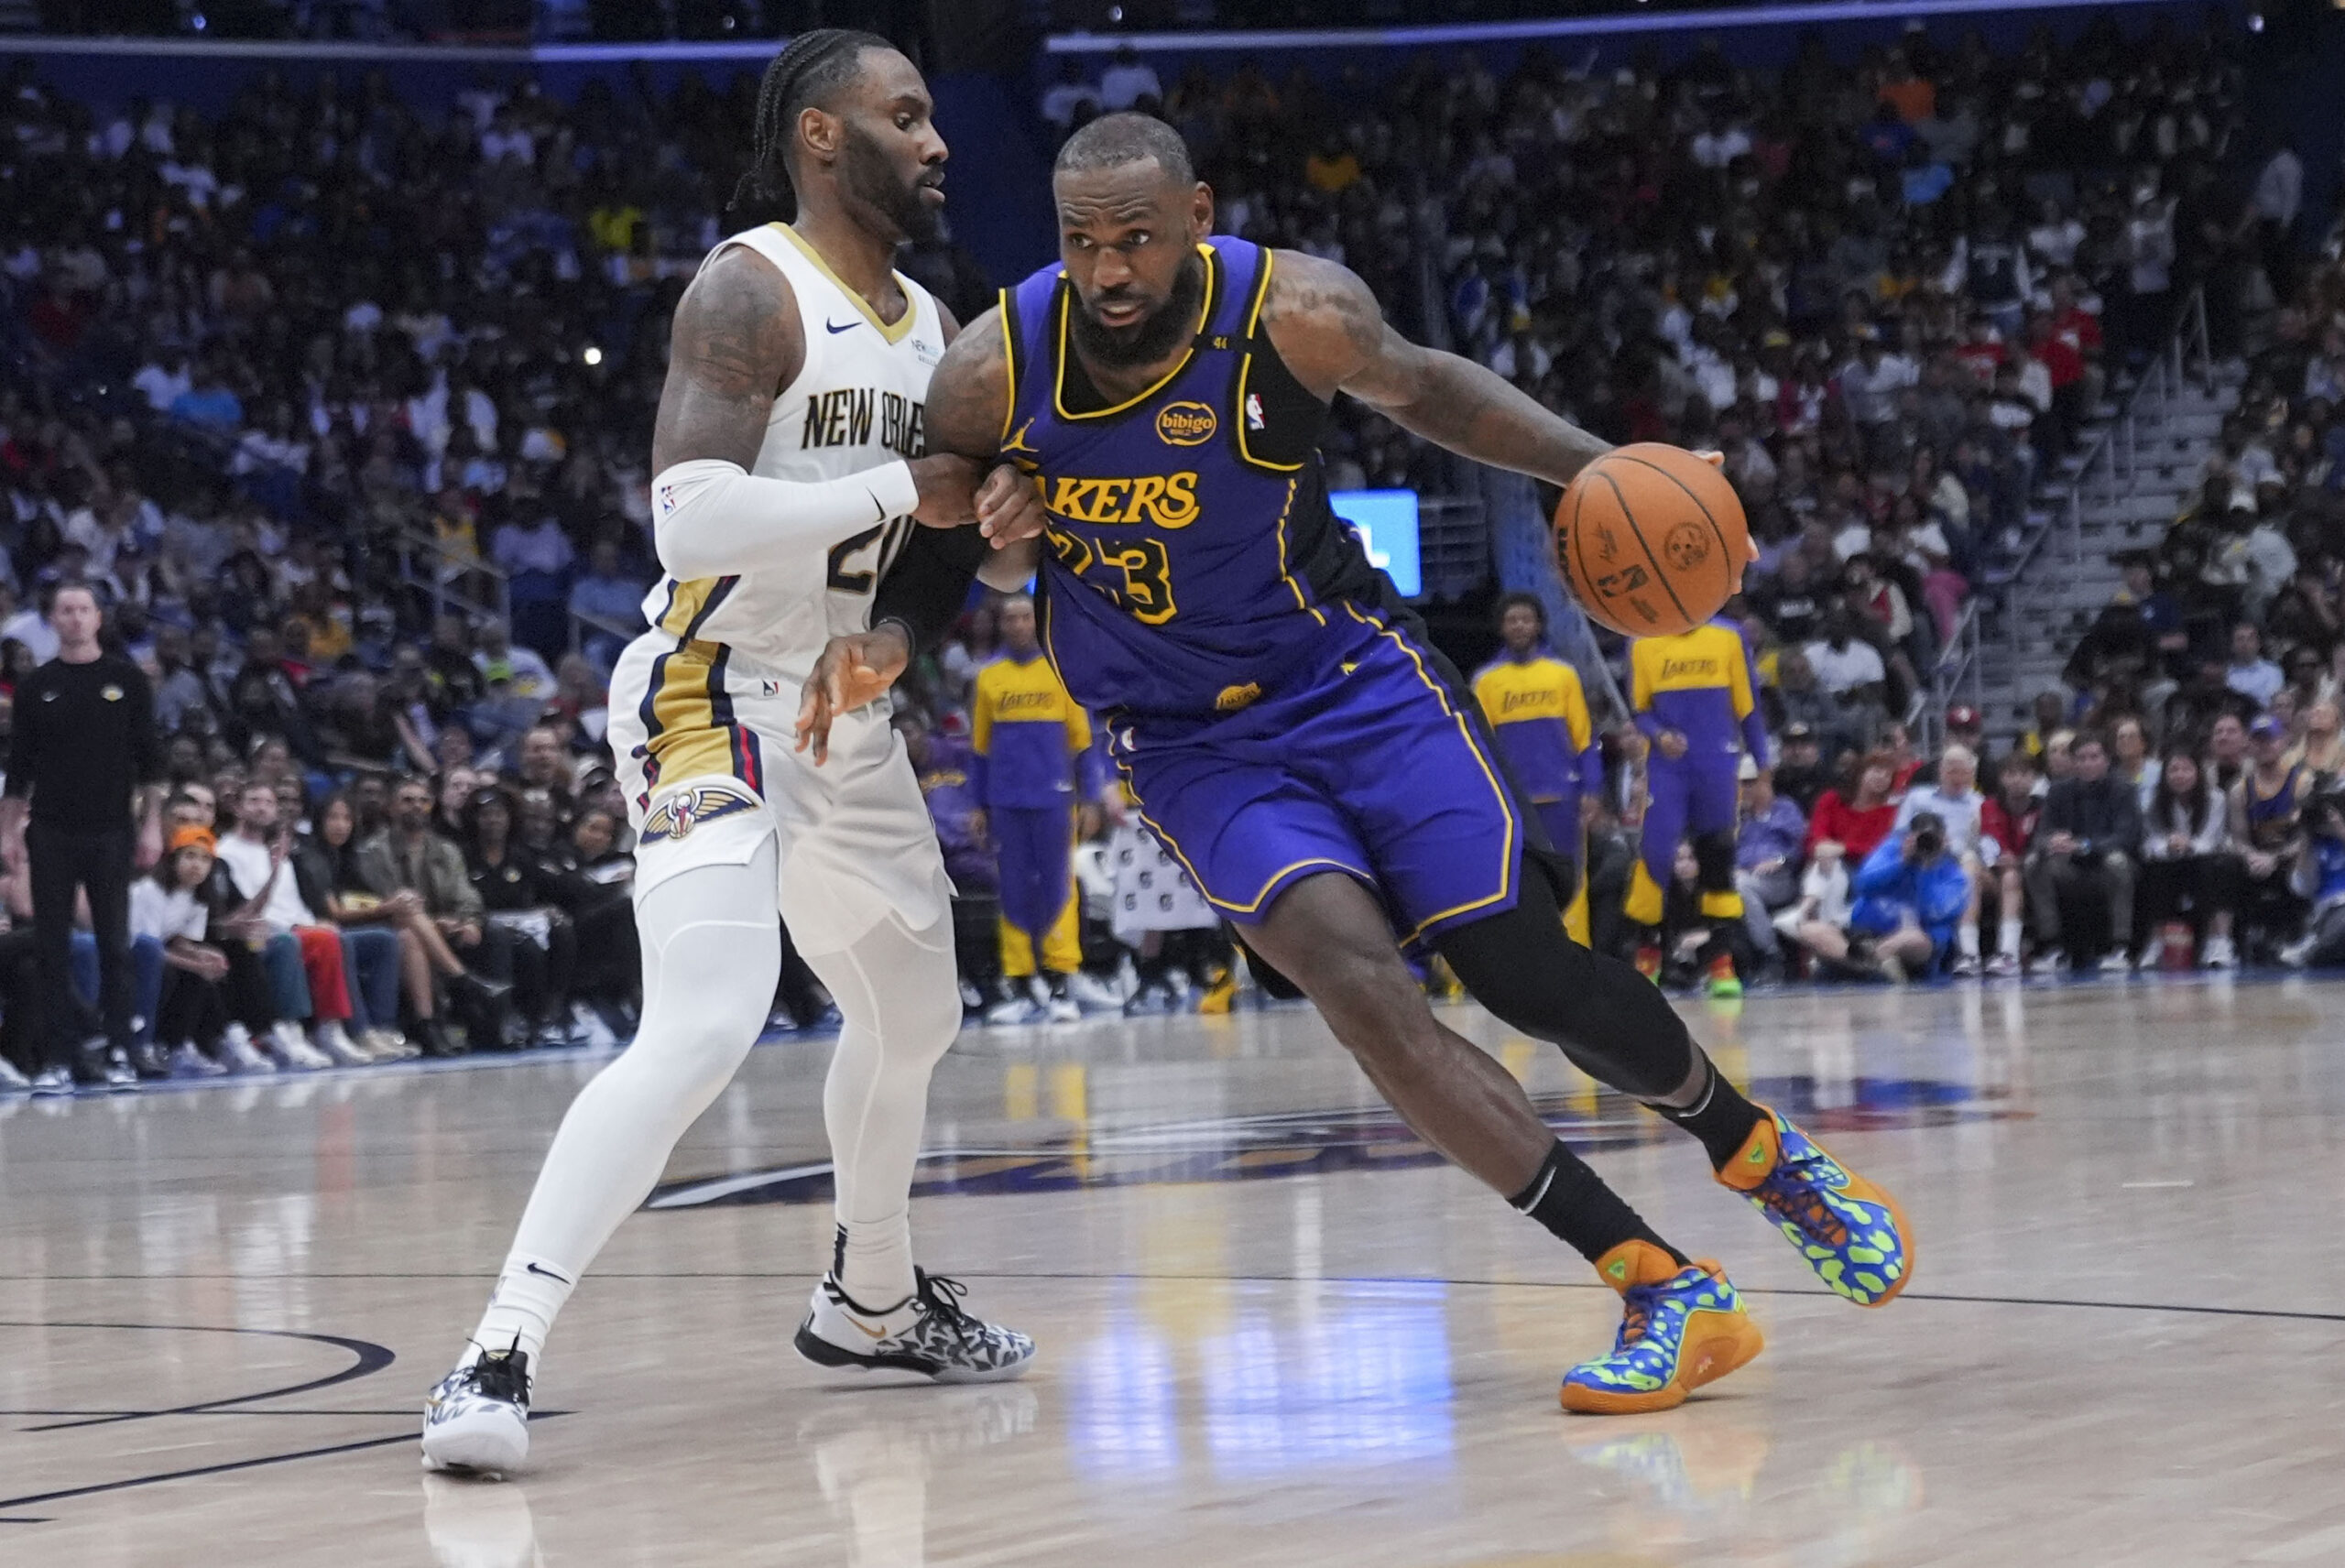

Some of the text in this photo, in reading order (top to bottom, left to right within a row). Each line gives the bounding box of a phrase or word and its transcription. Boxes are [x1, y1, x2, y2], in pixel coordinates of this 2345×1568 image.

[800, 387, 875, 451] NEW
[1162, 413, 1214, 434] bibigo
[1033, 471, 1200, 529] KERS
